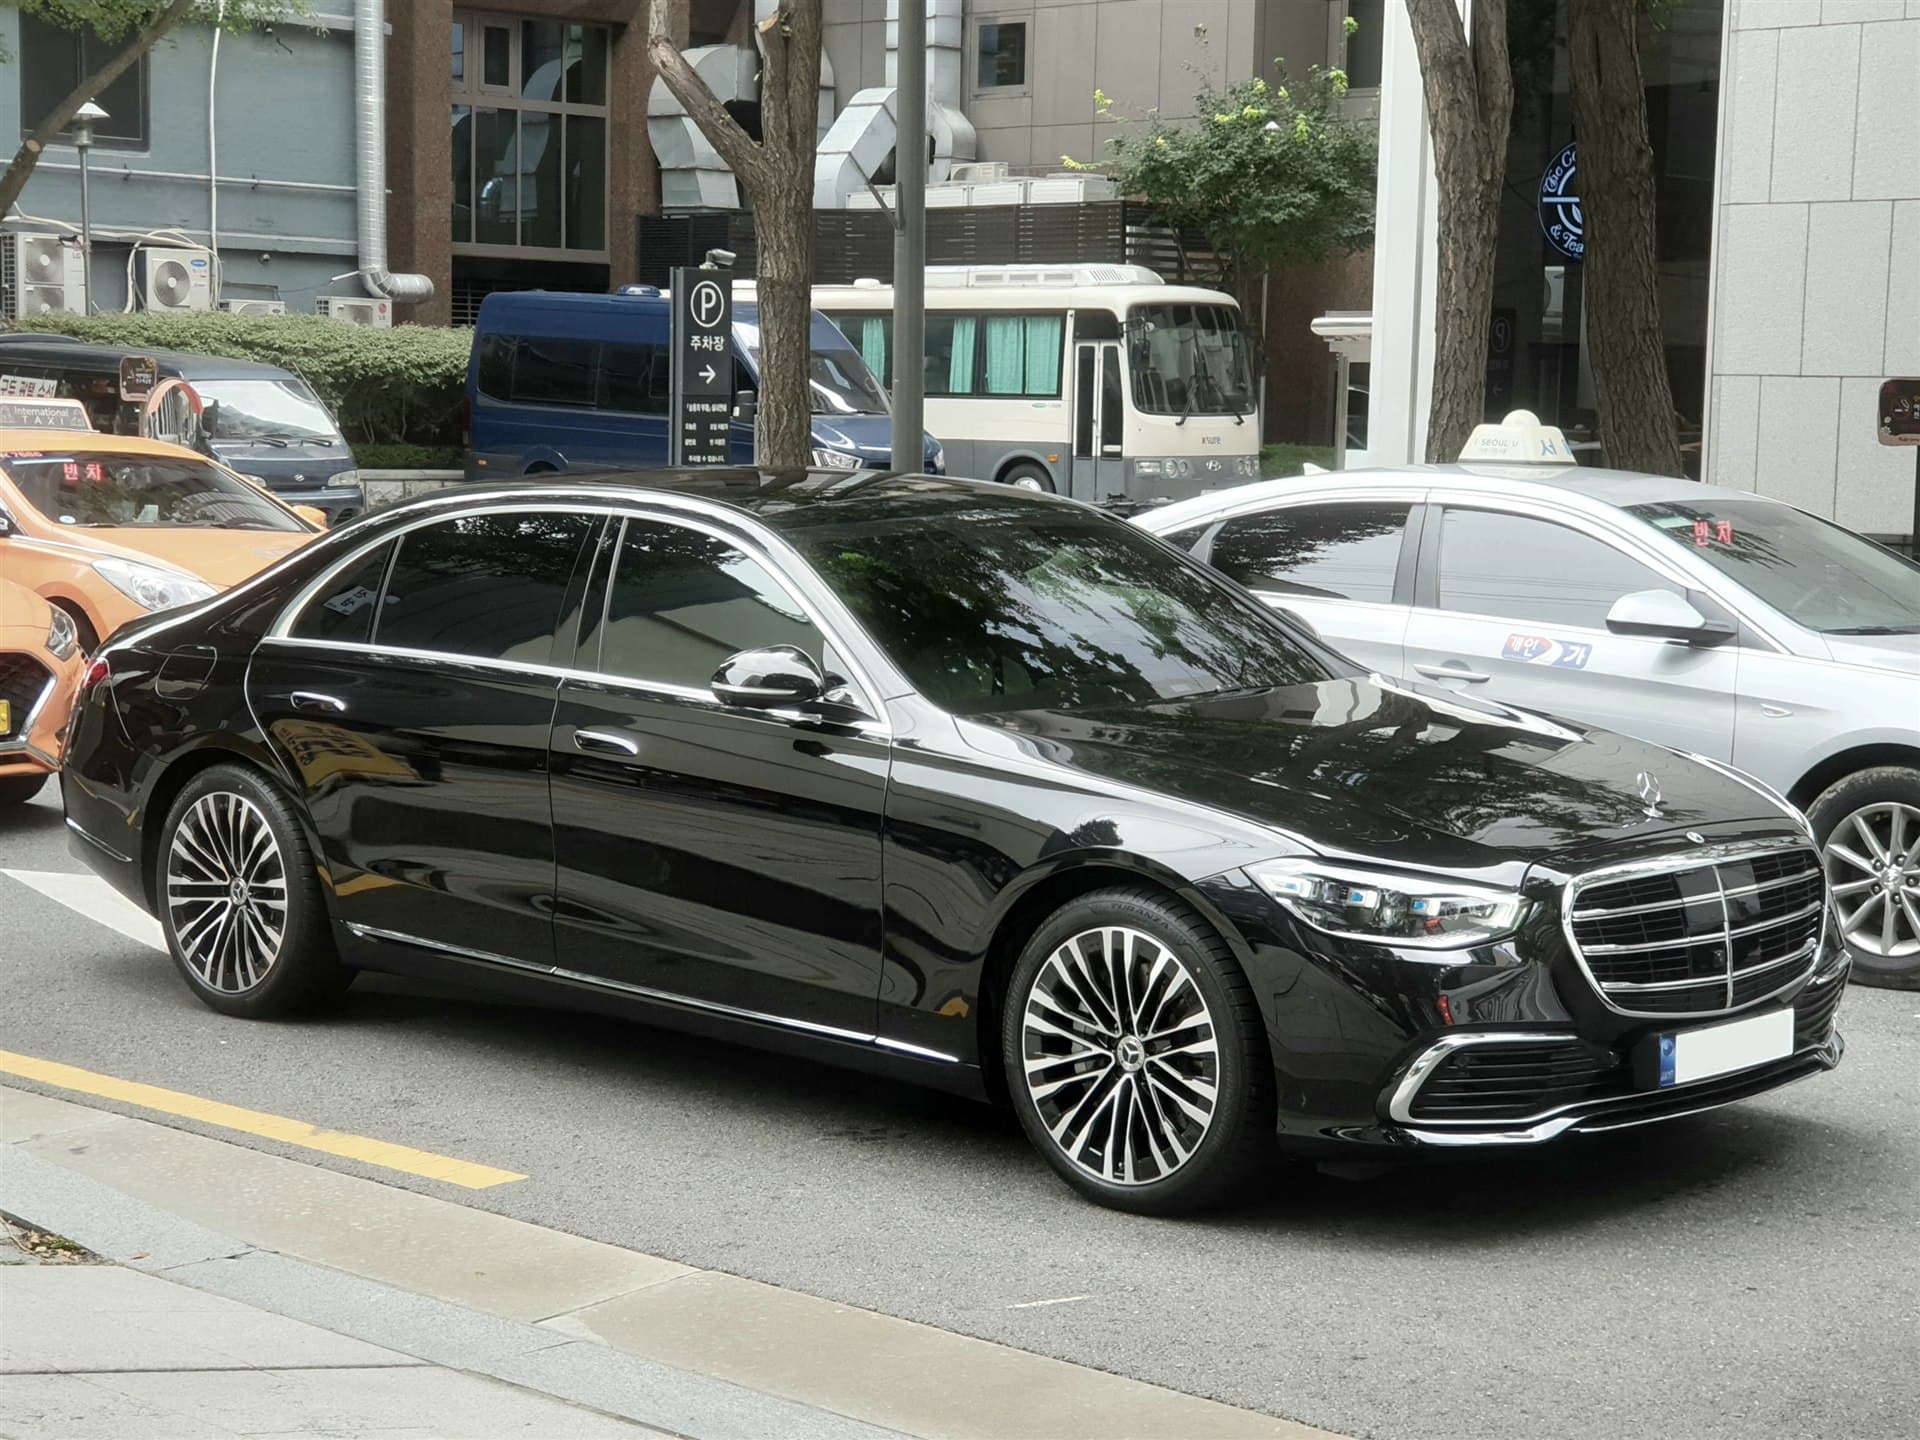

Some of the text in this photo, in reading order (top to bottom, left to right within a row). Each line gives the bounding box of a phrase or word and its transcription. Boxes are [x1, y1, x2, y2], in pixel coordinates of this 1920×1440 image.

[1543, 166, 1564, 193] The
[1550, 223, 1562, 240] &
[701, 288, 716, 320] P
[690, 335, 725, 352] 주차장
[14, 405, 69, 417] International
[22, 415, 65, 426] TAXI
[1509, 635, 1540, 658] 개인
